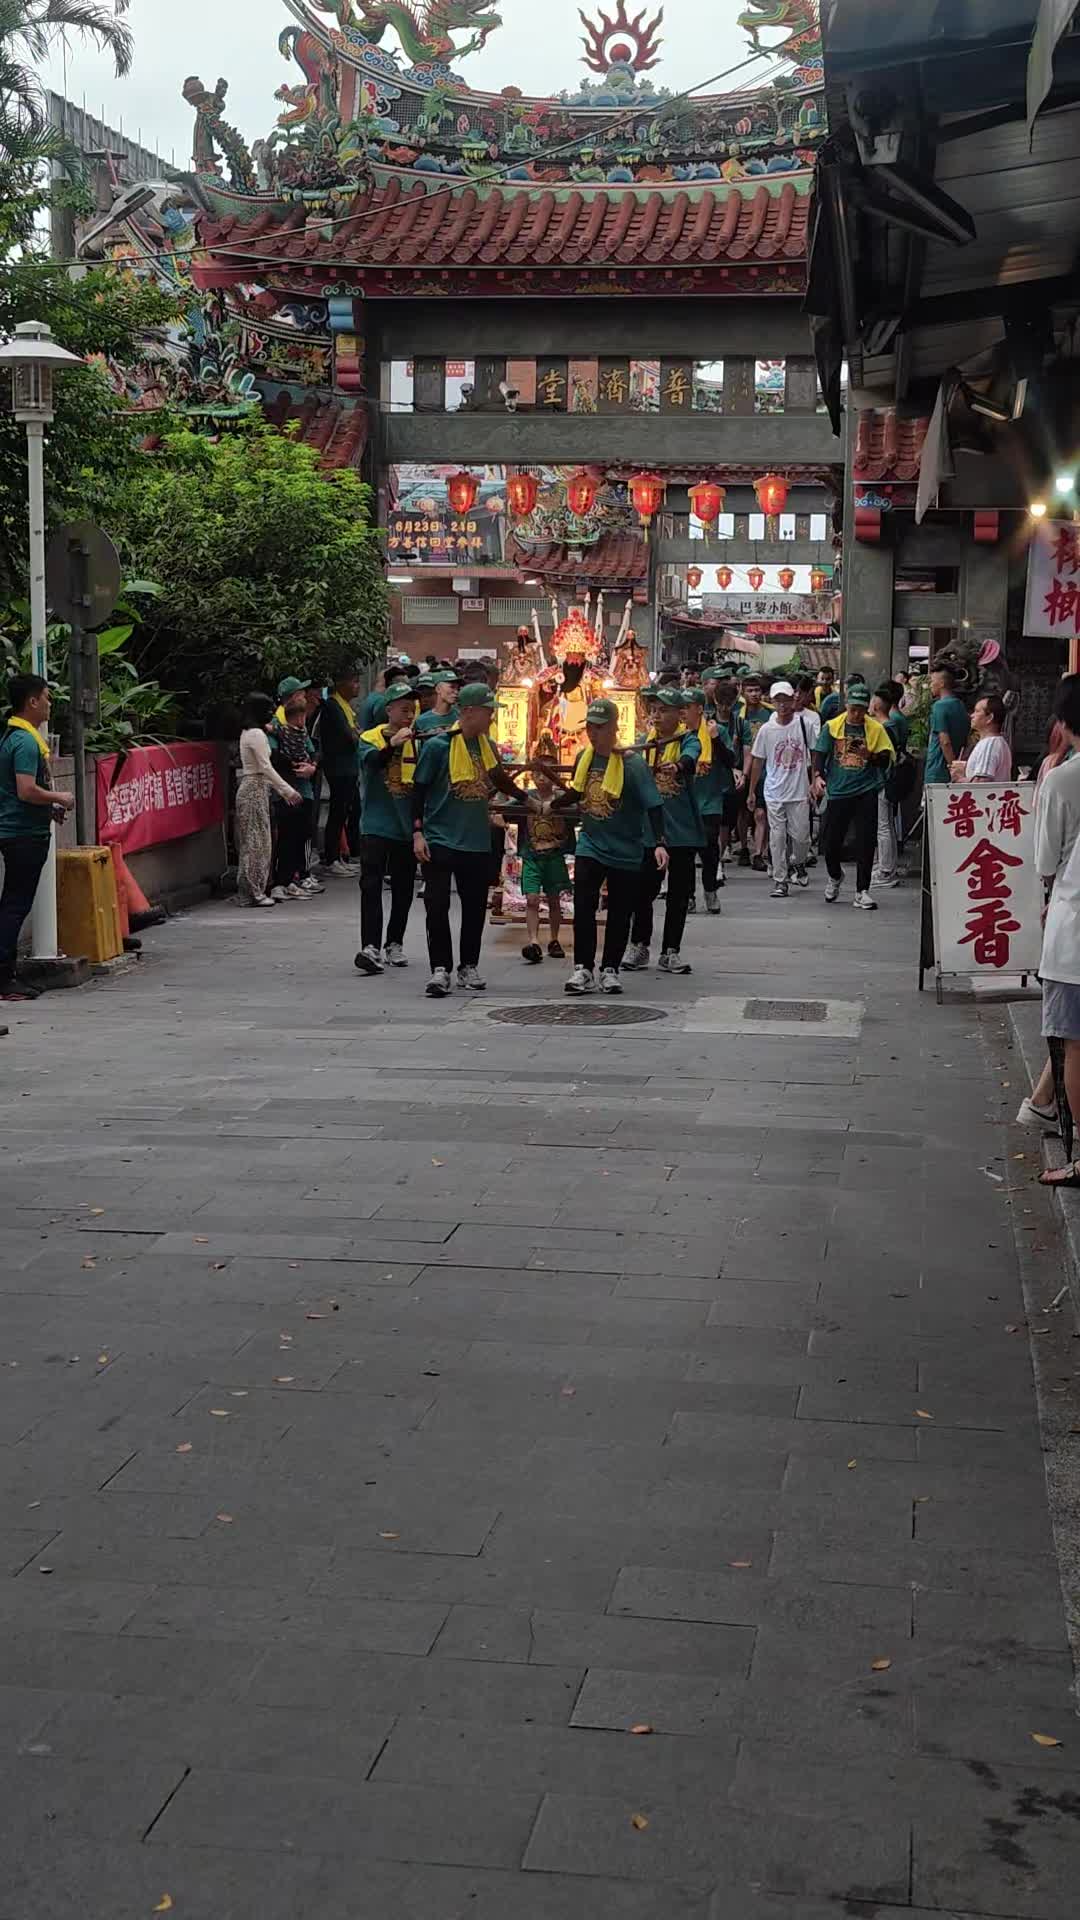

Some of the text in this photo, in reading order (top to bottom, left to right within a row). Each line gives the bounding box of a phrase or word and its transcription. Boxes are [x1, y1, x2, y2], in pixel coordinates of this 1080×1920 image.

[538, 369, 692, 405] 普濟堂
[740, 600, 792, 615] 巴黎小館
[943, 790, 1030, 838] 普濟
[955, 838, 1023, 968] 金香
